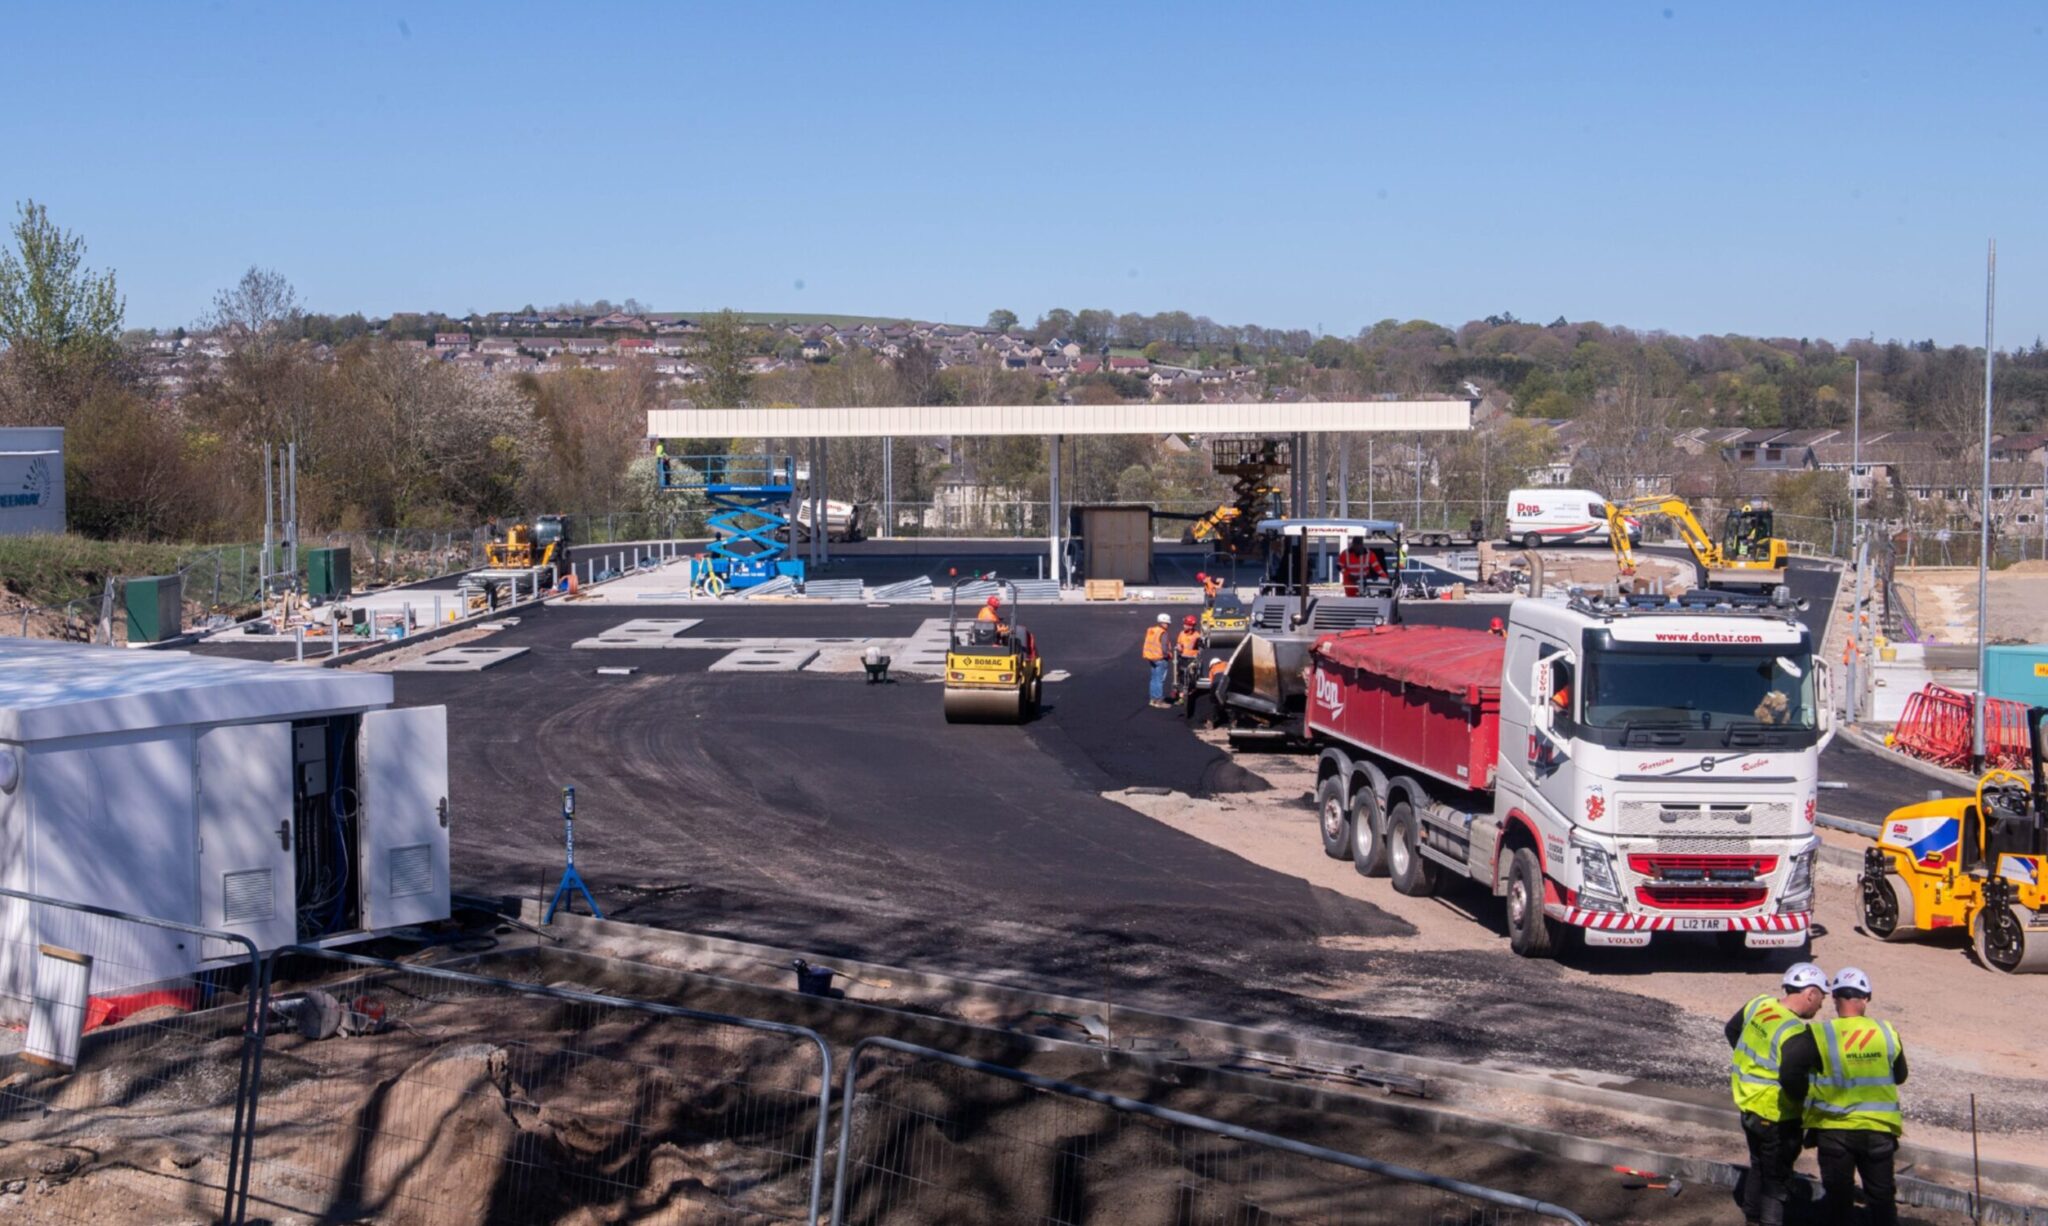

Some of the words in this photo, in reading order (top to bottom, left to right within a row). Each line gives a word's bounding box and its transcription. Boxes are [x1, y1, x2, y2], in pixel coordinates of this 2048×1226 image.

[1655, 632, 1763, 643] www.dontar.com
[974, 658, 1002, 666] BOMAG
[1315, 667, 1340, 709] Don
[1701, 919, 1720, 930] TAR
[1607, 937, 1643, 945] VOLVO
[1751, 938, 1785, 946] VOLVO
[1846, 1051, 1882, 1059] WILLIAMS
